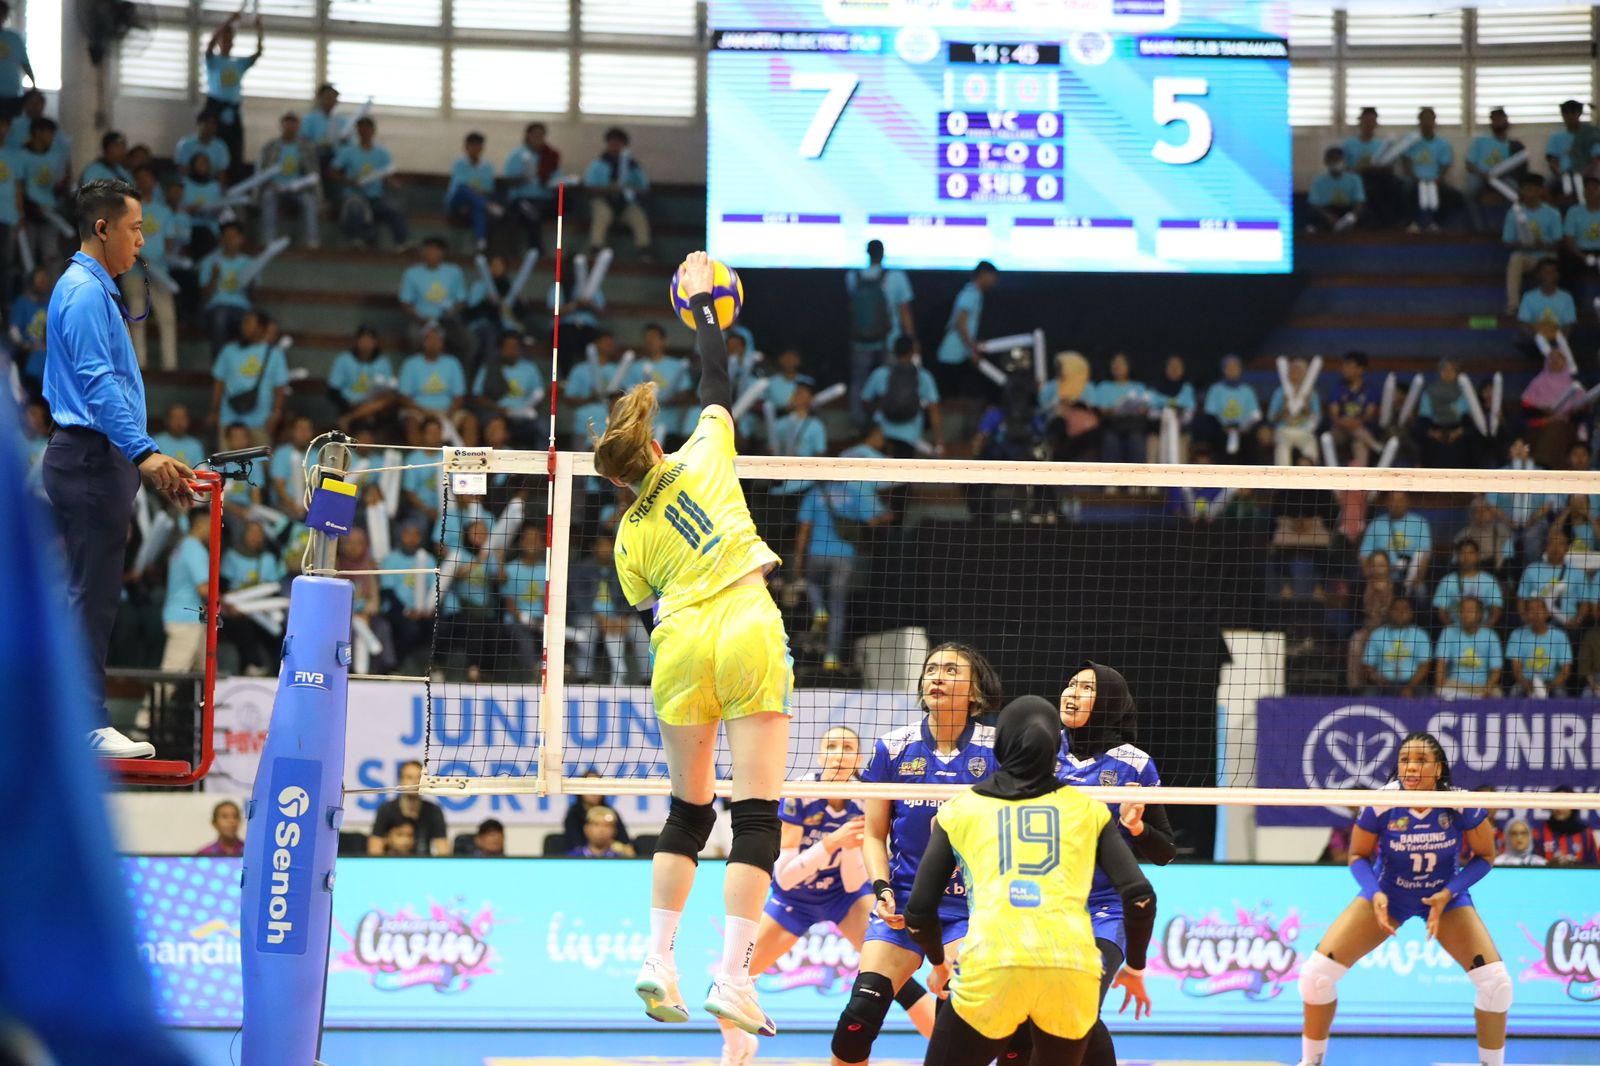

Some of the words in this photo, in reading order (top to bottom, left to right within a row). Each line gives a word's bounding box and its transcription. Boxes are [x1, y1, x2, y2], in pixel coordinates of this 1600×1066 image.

[964, 73, 989, 104] 0
[1017, 75, 1041, 103] 0
[789, 73, 860, 160] 7
[946, 111, 969, 136] 0
[1036, 112, 1059, 137] 0
[1151, 76, 1214, 165] 5
[946, 141, 969, 167] 0
[1036, 142, 1059, 168] 0
[946, 172, 969, 198] 0
[1036, 174, 1059, 200] 0
[664, 490, 715, 550] 11
[294, 670, 325, 685] FIVB
[997, 805, 1061, 876] 19
[1400, 832, 1446, 845] BANDUNG
[1407, 839, 1456, 852] Tandamata
[266, 820, 301, 945] Senoh
[742, 941, 755, 969] KELME
